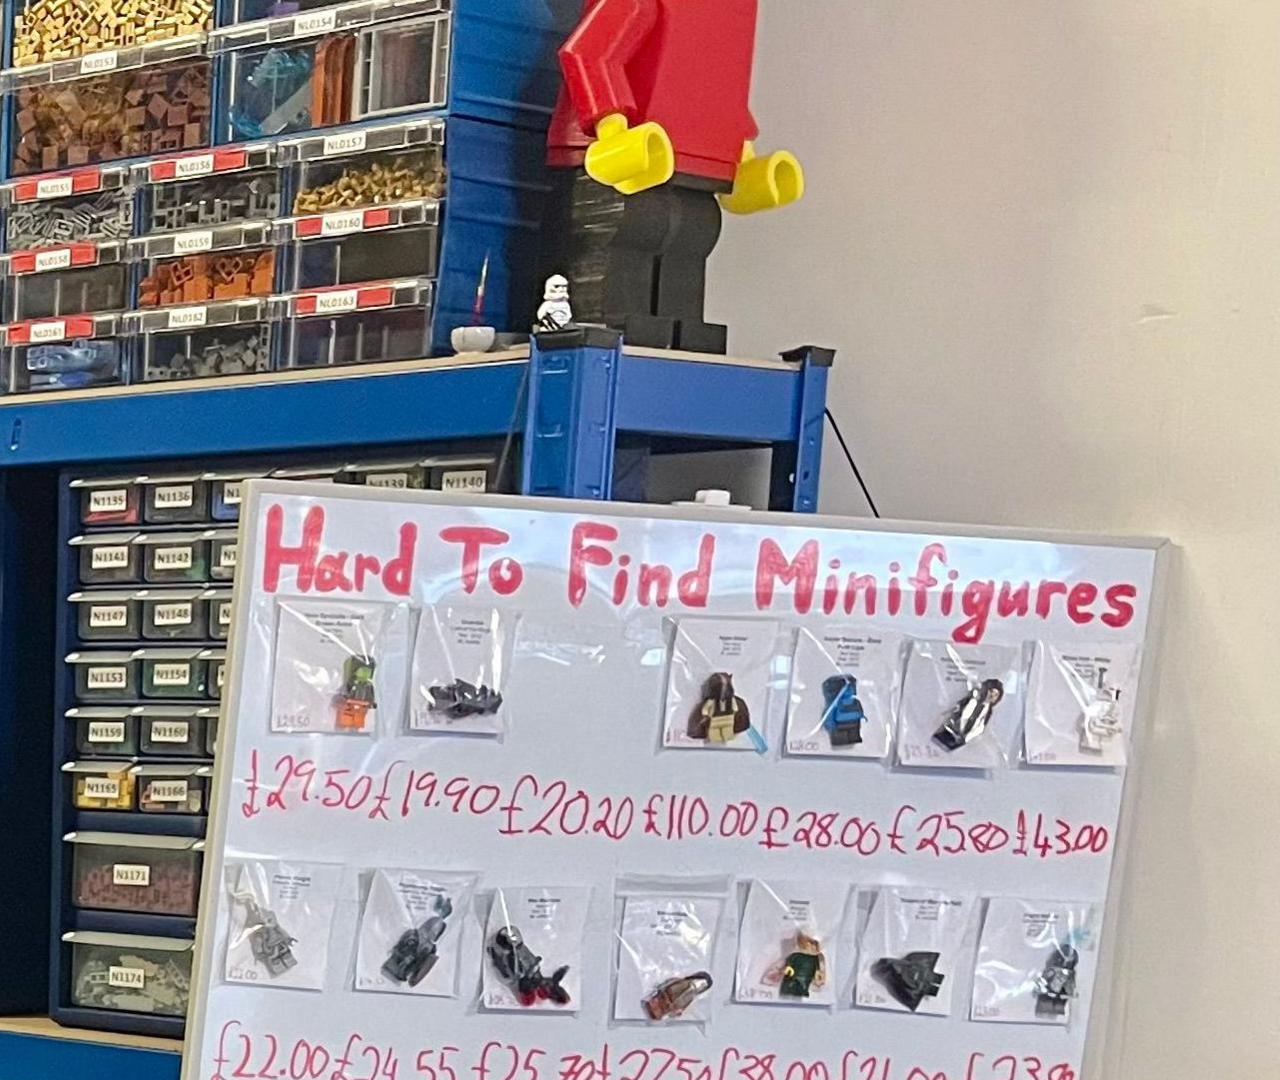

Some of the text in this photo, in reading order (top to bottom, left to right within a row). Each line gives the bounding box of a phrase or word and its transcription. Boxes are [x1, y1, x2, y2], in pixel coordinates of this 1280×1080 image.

[327, 137, 363, 150] NL0157
[319, 297, 355, 309] NL0163
[444, 475, 484, 489] N1140
[93, 495, 124, 506] N1135
[157, 492, 191, 502] N1136
[262, 502, 1138, 645] Hard To Find Minifigures
[93, 610, 125, 621] N1147
[91, 671, 124, 683] N1153
[241, 749, 372, 818] £29.50
[369, 760, 502, 822] £19.90
[643, 793, 758, 841] £110.00
[759, 806, 882, 855] £28.00
[111, 972, 142, 983] N1174
